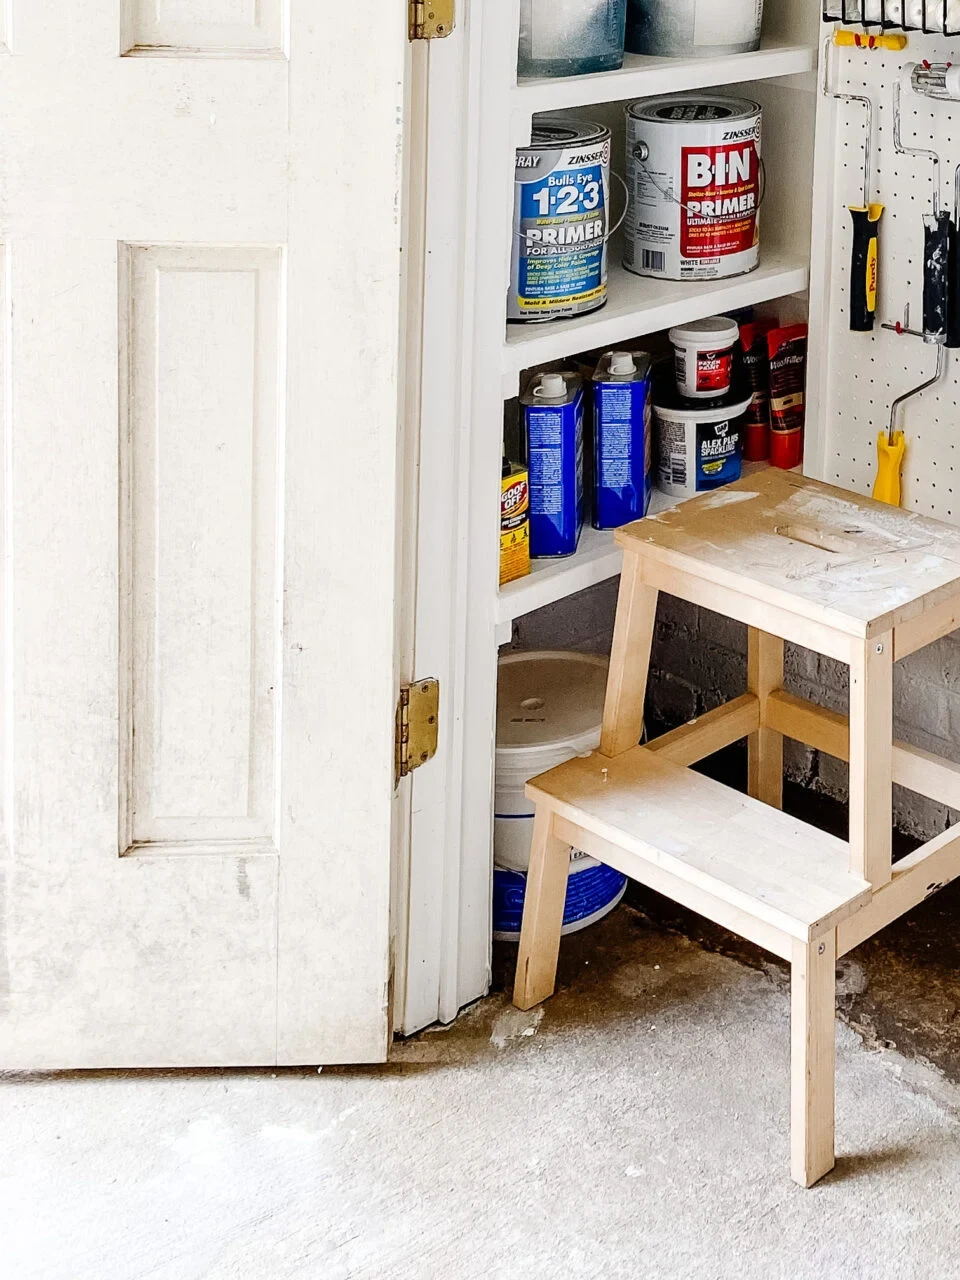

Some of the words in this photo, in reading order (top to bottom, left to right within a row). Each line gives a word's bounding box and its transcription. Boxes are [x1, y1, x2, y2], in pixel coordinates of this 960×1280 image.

[722, 126, 756, 141] ZINSSER
[567, 151, 604, 165] ZINSSER
[548, 174, 574, 187] Bulls
[576, 172, 593, 185] Eye
[687, 192, 755, 217] PRIMER
[525, 219, 603, 247] PRIMER
[526, 247, 547, 256] FOR
[550, 246, 567, 254] ALL
[869, 257, 878, 293] Purdy
[701, 438, 722, 449] ALEX
[722, 433, 739, 446] PLUS
[701, 443, 736, 457] SPACKLING
[501, 481, 526, 502] GOOF
[504, 494, 522, 510] OFF
